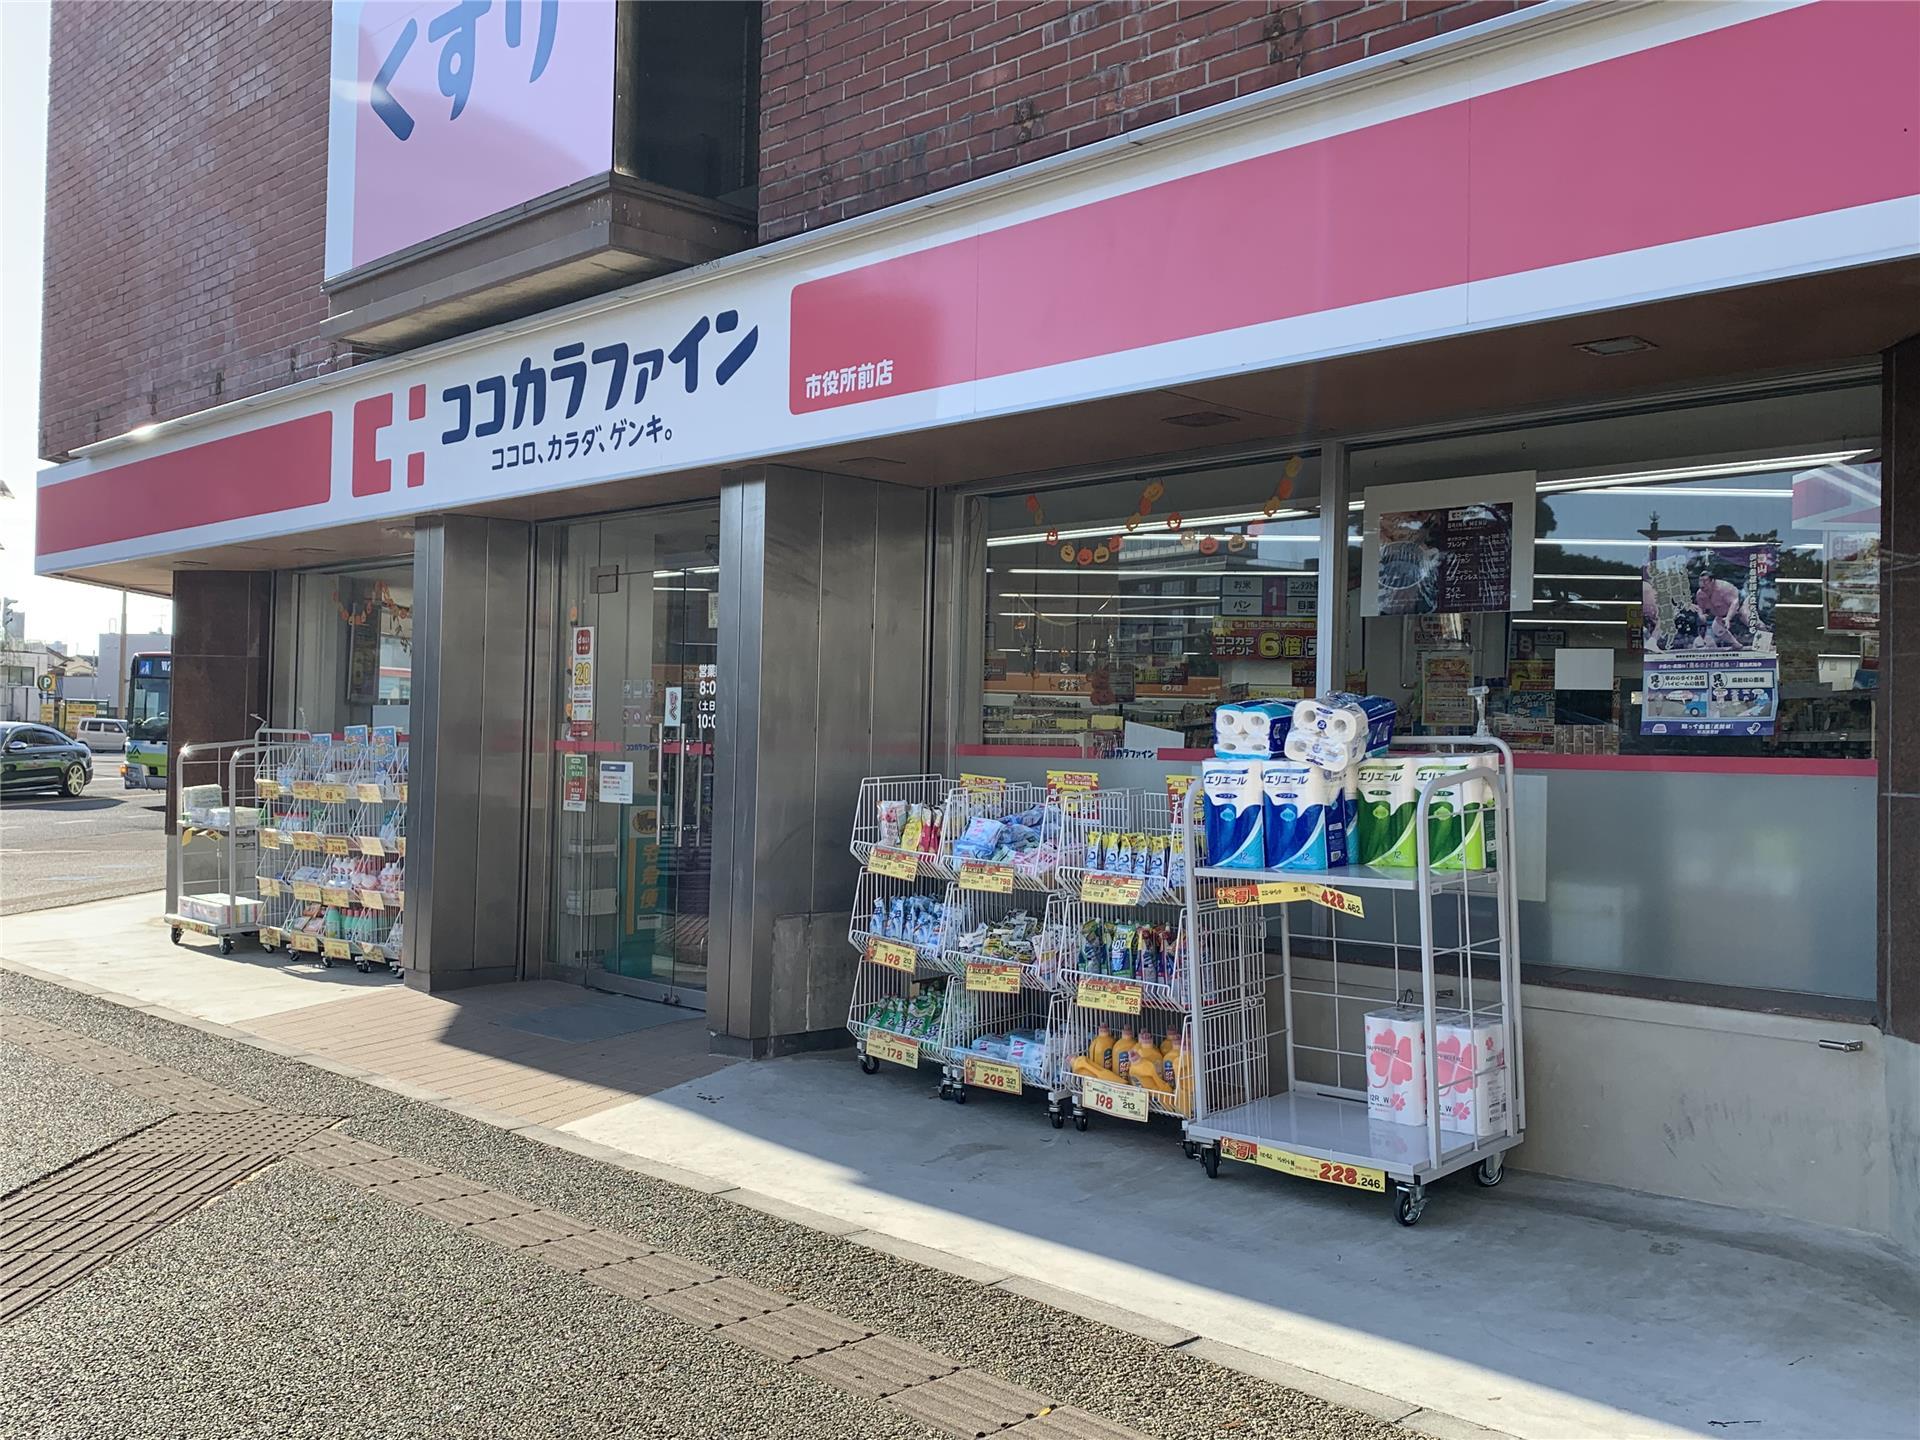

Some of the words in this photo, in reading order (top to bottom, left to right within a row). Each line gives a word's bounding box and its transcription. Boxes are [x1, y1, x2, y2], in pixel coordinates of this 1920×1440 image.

[371, 0, 558, 141] くすり
[441, 309, 759, 445] ココカラファイン
[805, 360, 893, 400] 市役所前店
[491, 414, 672, 471] ココロ、カラダ、ゲンキ。
[1268, 586, 1278, 606] 1
[1233, 600, 1251, 609] パン
[1215, 636, 1254, 645] ココカラ
[1216, 647, 1254, 655] ポイント
[575, 662, 592, 685] 20
[699, 664, 717, 677] 営業
[1204, 774, 1248, 785] エリエール
[1264, 774, 1309, 785] エリエール
[1358, 770, 1402, 782] エリエール
[1320, 890, 1346, 910] 428
[1346, 902, 1361, 914] 462
[884, 952, 901, 966] 198
[1124, 998, 1139, 1007] 528
[887, 1047, 903, 1060] 178
[983, 1072, 1005, 1087] 298
[1095, 1093, 1113, 1110] 198
[1122, 1101, 1136, 1110] 213
[1318, 1162, 1357, 1185] 228
[1360, 1176, 1381, 1190] 246
